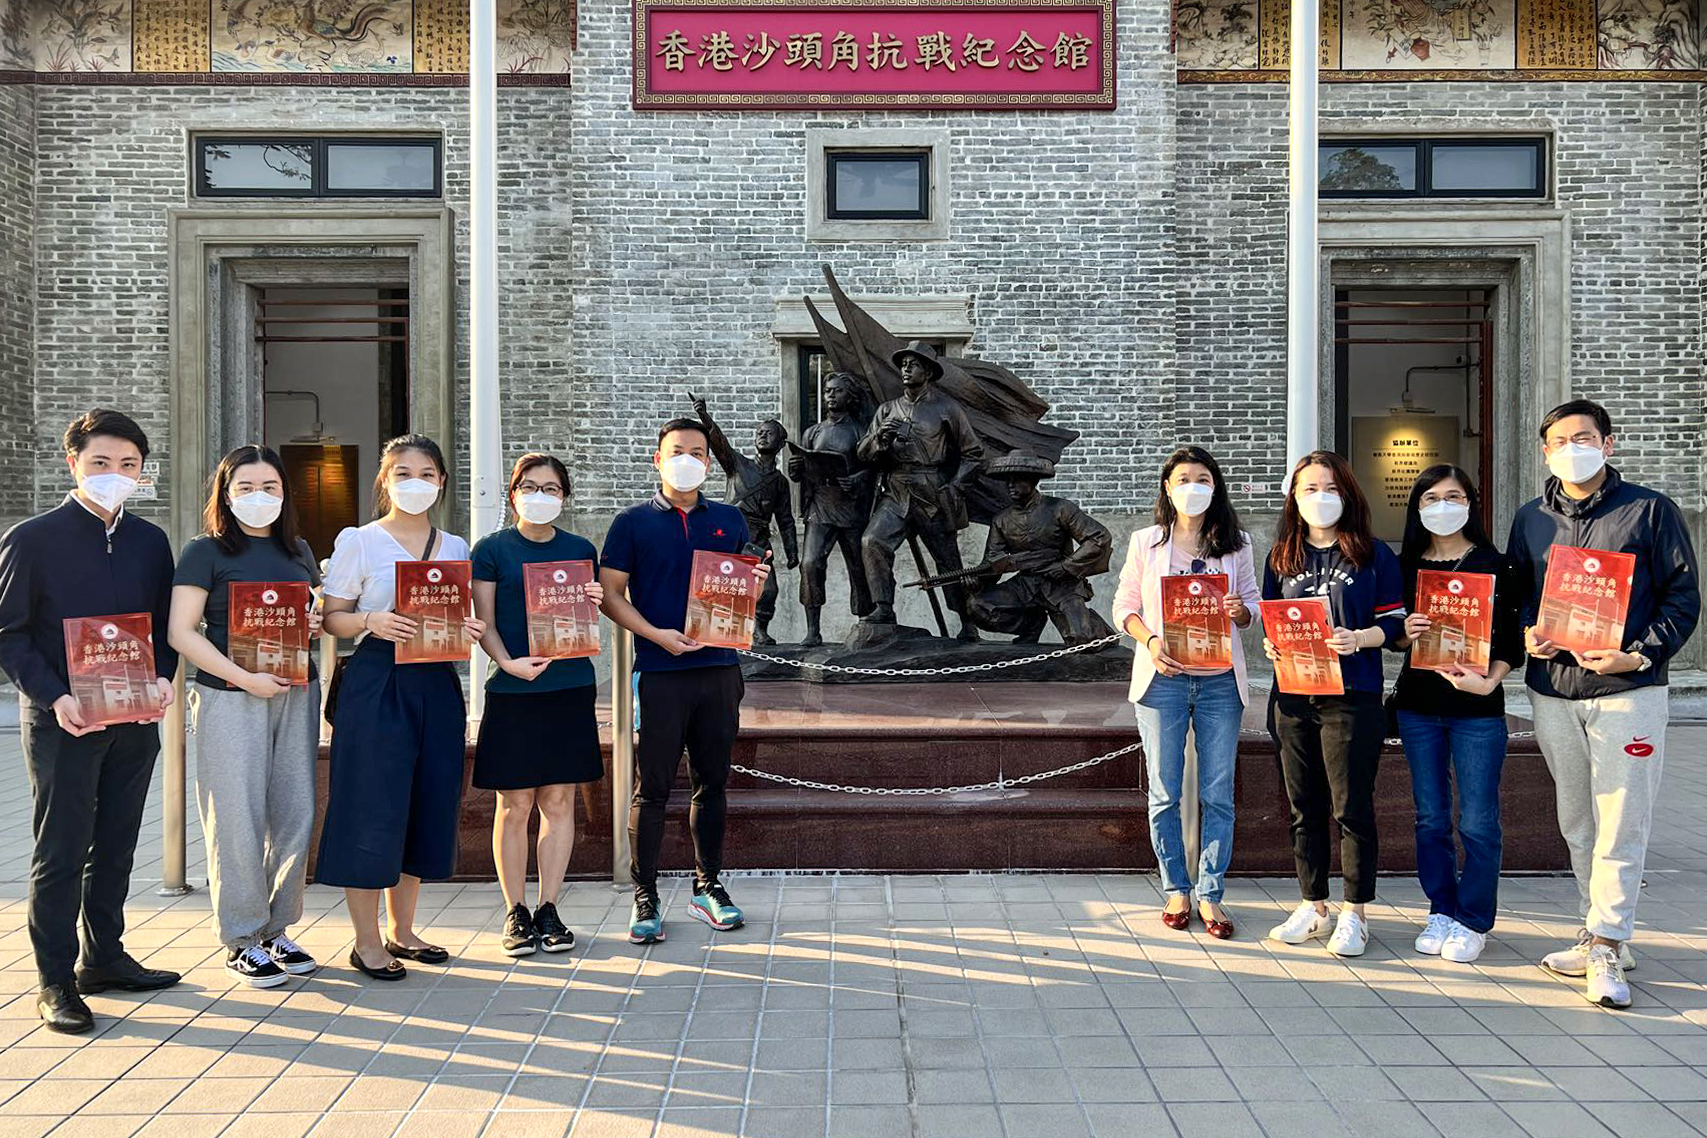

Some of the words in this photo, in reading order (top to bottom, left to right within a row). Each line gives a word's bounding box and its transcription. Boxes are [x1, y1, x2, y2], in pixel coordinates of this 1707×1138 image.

[655, 29, 1093, 72] 香港沙頭角抗戰紀念館
[704, 575, 747, 587] 香港沙頭角
[1289, 567, 1354, 587] HOLITER
[1562, 573, 1617, 588] 香港沙頭角
[410, 584, 459, 595] 香港沙頭角
[538, 584, 584, 596] 香港沙頭角
[702, 584, 748, 596] 抗戰紀念館
[1560, 583, 1616, 598] 抗戰紀念館
[409, 595, 460, 605] 抗戰紀念館
[539, 594, 585, 606] 抗戰紀念館
[1174, 597, 1218, 606] 香港沙頭角
[1430, 594, 1479, 607] 香港沙頭角
[244, 607, 296, 617] 香港沙頭角
[1174, 606, 1219, 616] 抗戰紀念館
[1429, 605, 1480, 617] 抗戰紀念館
[243, 617, 297, 627] 抗戰紀念館
[1276, 621, 1320, 632] 香港沙頭角
[1277, 631, 1322, 641] 抗戰紀念館
[83, 640, 138, 653] 香港沙頭角
[83, 651, 141, 665] 抗戰紀念館
